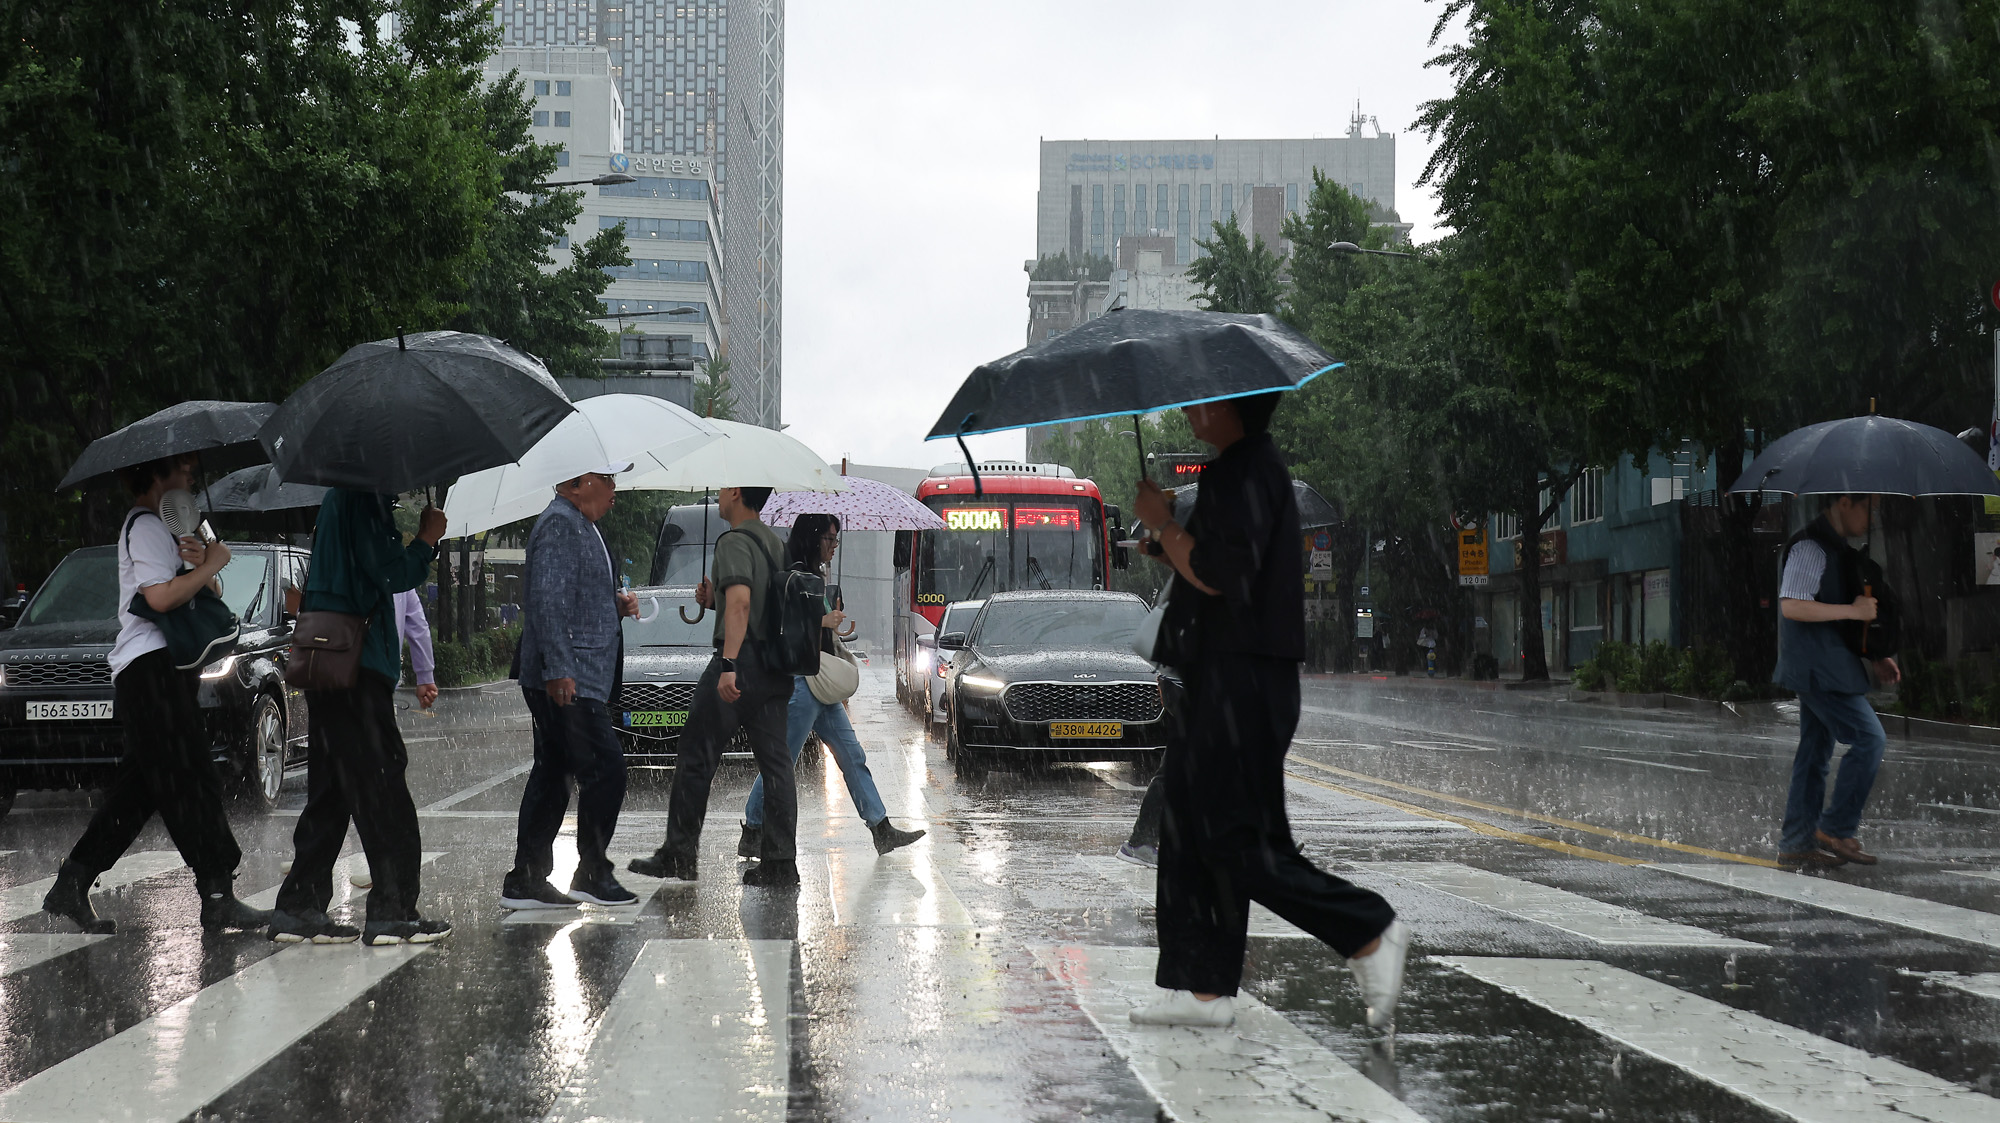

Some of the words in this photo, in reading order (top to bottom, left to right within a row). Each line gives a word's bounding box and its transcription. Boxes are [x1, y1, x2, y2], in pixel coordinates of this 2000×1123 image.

[635, 157, 702, 174] 신한은행
[947, 511, 1002, 530] 5000A
[1462, 550, 1484, 558] 단속중
[917, 593, 945, 603] 5000
[32, 704, 68, 718] 156조
[72, 703, 108, 717] 5317
[666, 712, 688, 725] 308
[1087, 724, 1117, 736] 4426
